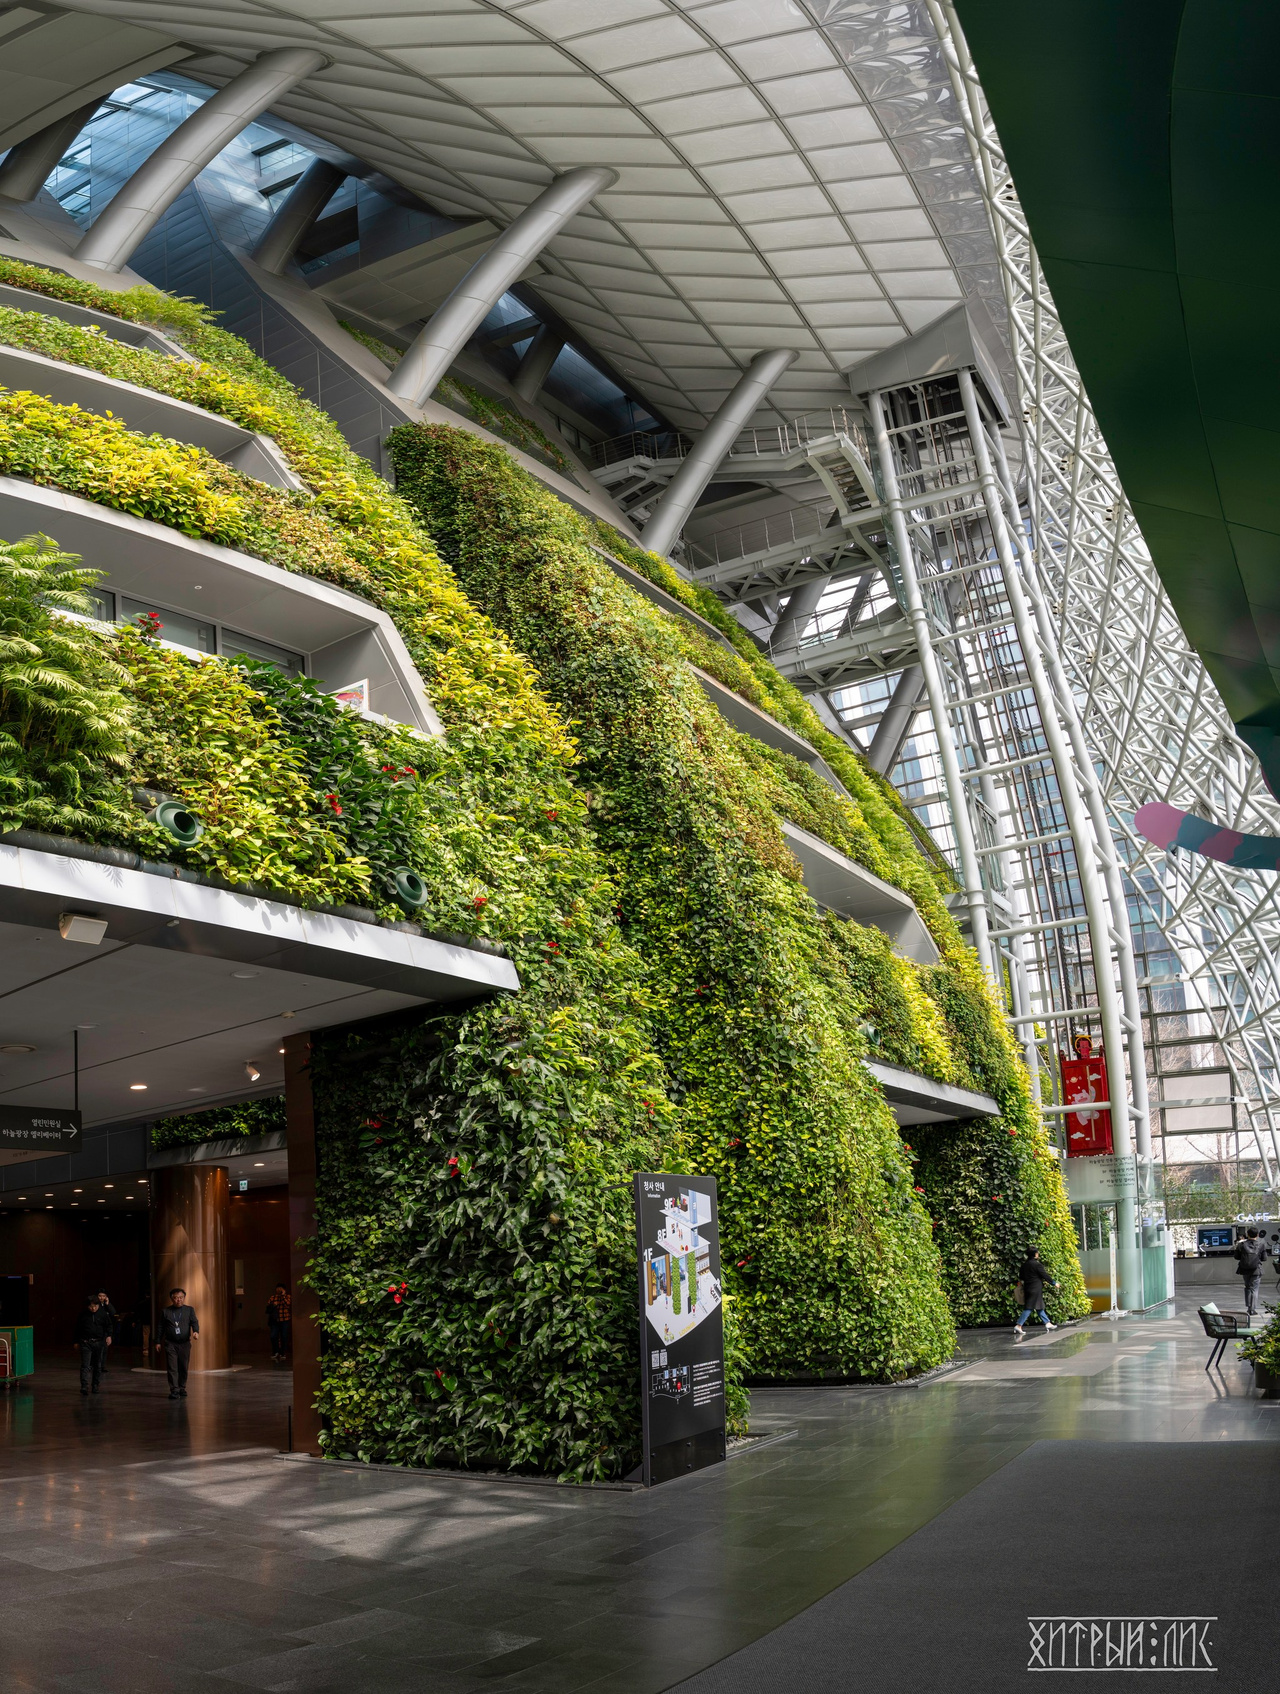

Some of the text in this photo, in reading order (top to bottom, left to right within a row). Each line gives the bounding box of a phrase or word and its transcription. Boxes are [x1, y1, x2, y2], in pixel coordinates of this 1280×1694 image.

[31, 1118, 61, 1129] 열린민원실
[2, 1128, 62, 1140] 하늘광장 엘리베이터
[643, 1181, 665, 1192] 청사 안내
[664, 1197, 673, 1210] 9F
[1237, 1212, 1270, 1223] CAFE
[657, 1229, 666, 1242] 8F
[643, 1247, 653, 1261] 1F
